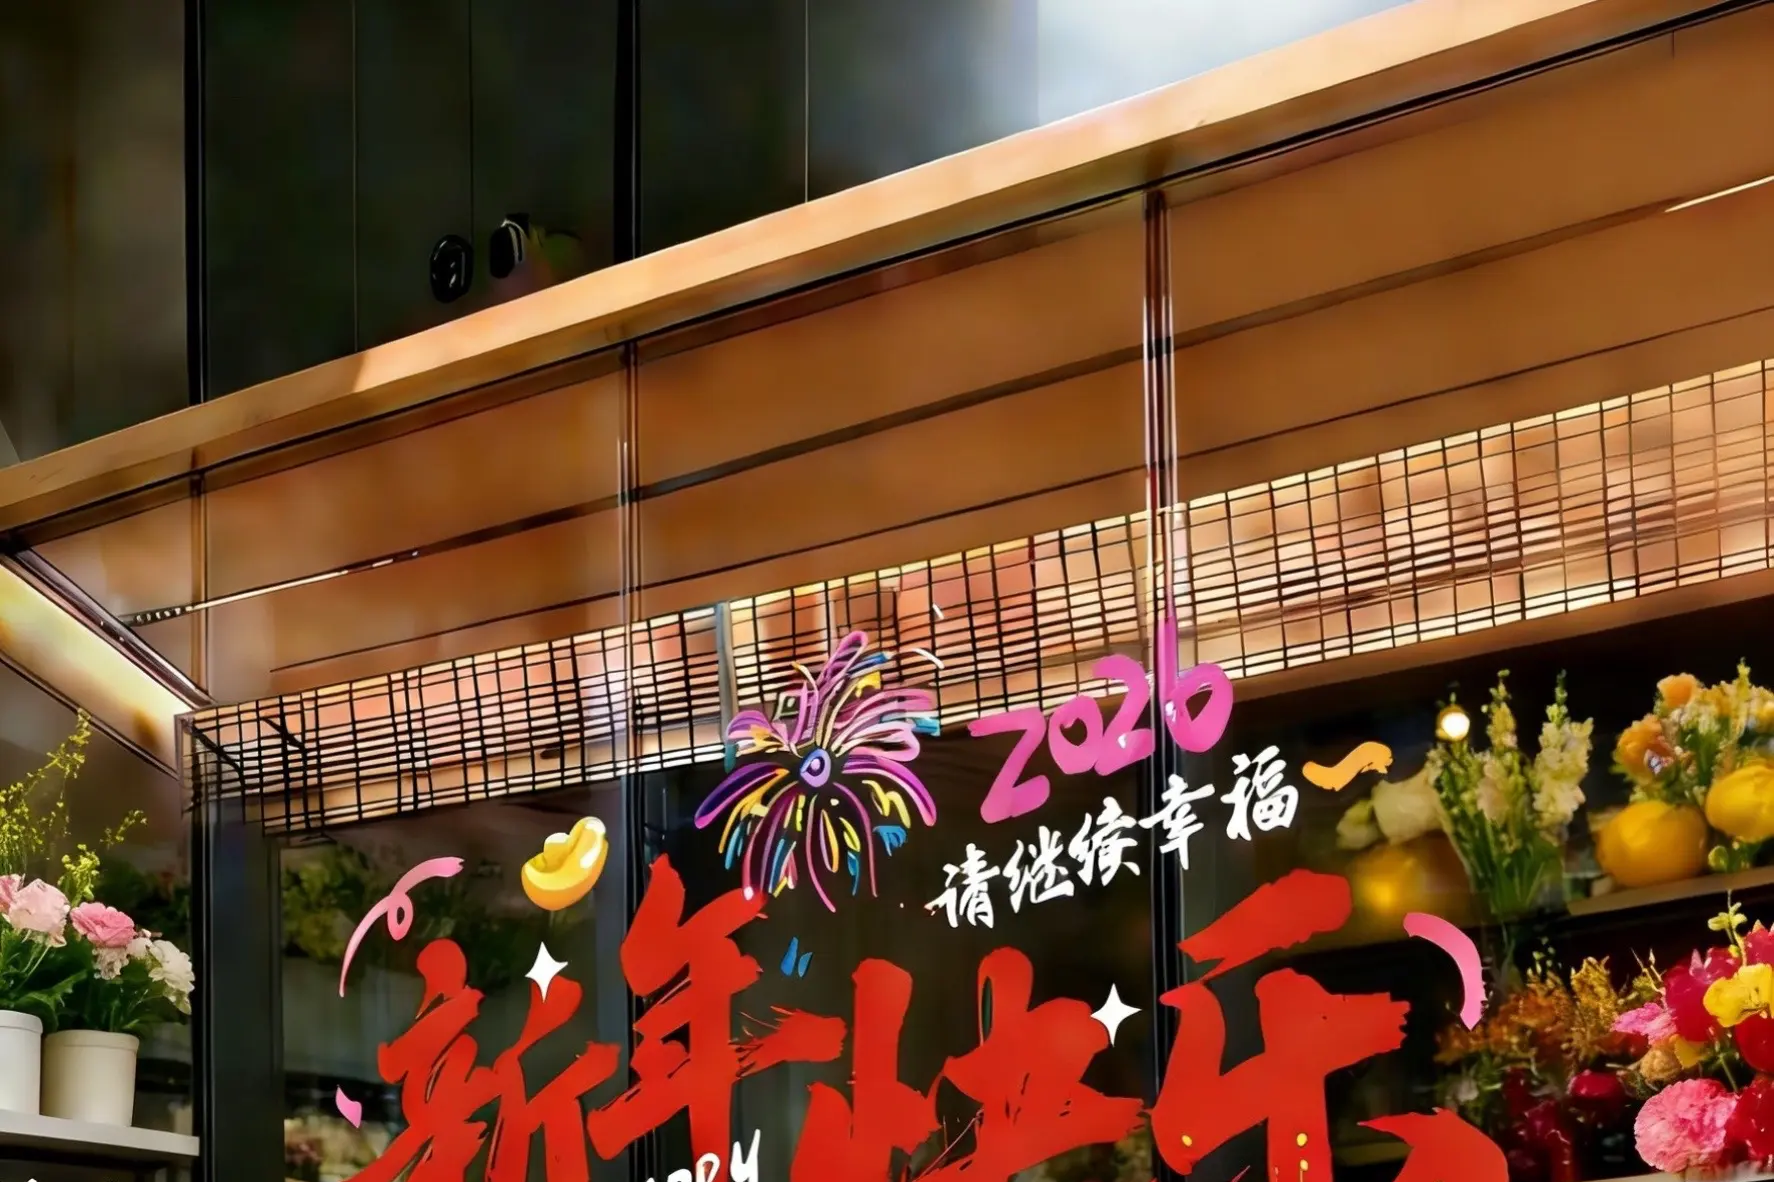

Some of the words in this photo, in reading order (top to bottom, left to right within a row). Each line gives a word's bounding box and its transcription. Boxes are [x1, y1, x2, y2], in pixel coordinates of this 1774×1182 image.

[968, 612, 1234, 824] 2026
[925, 745, 1299, 928] 请继续幸福
